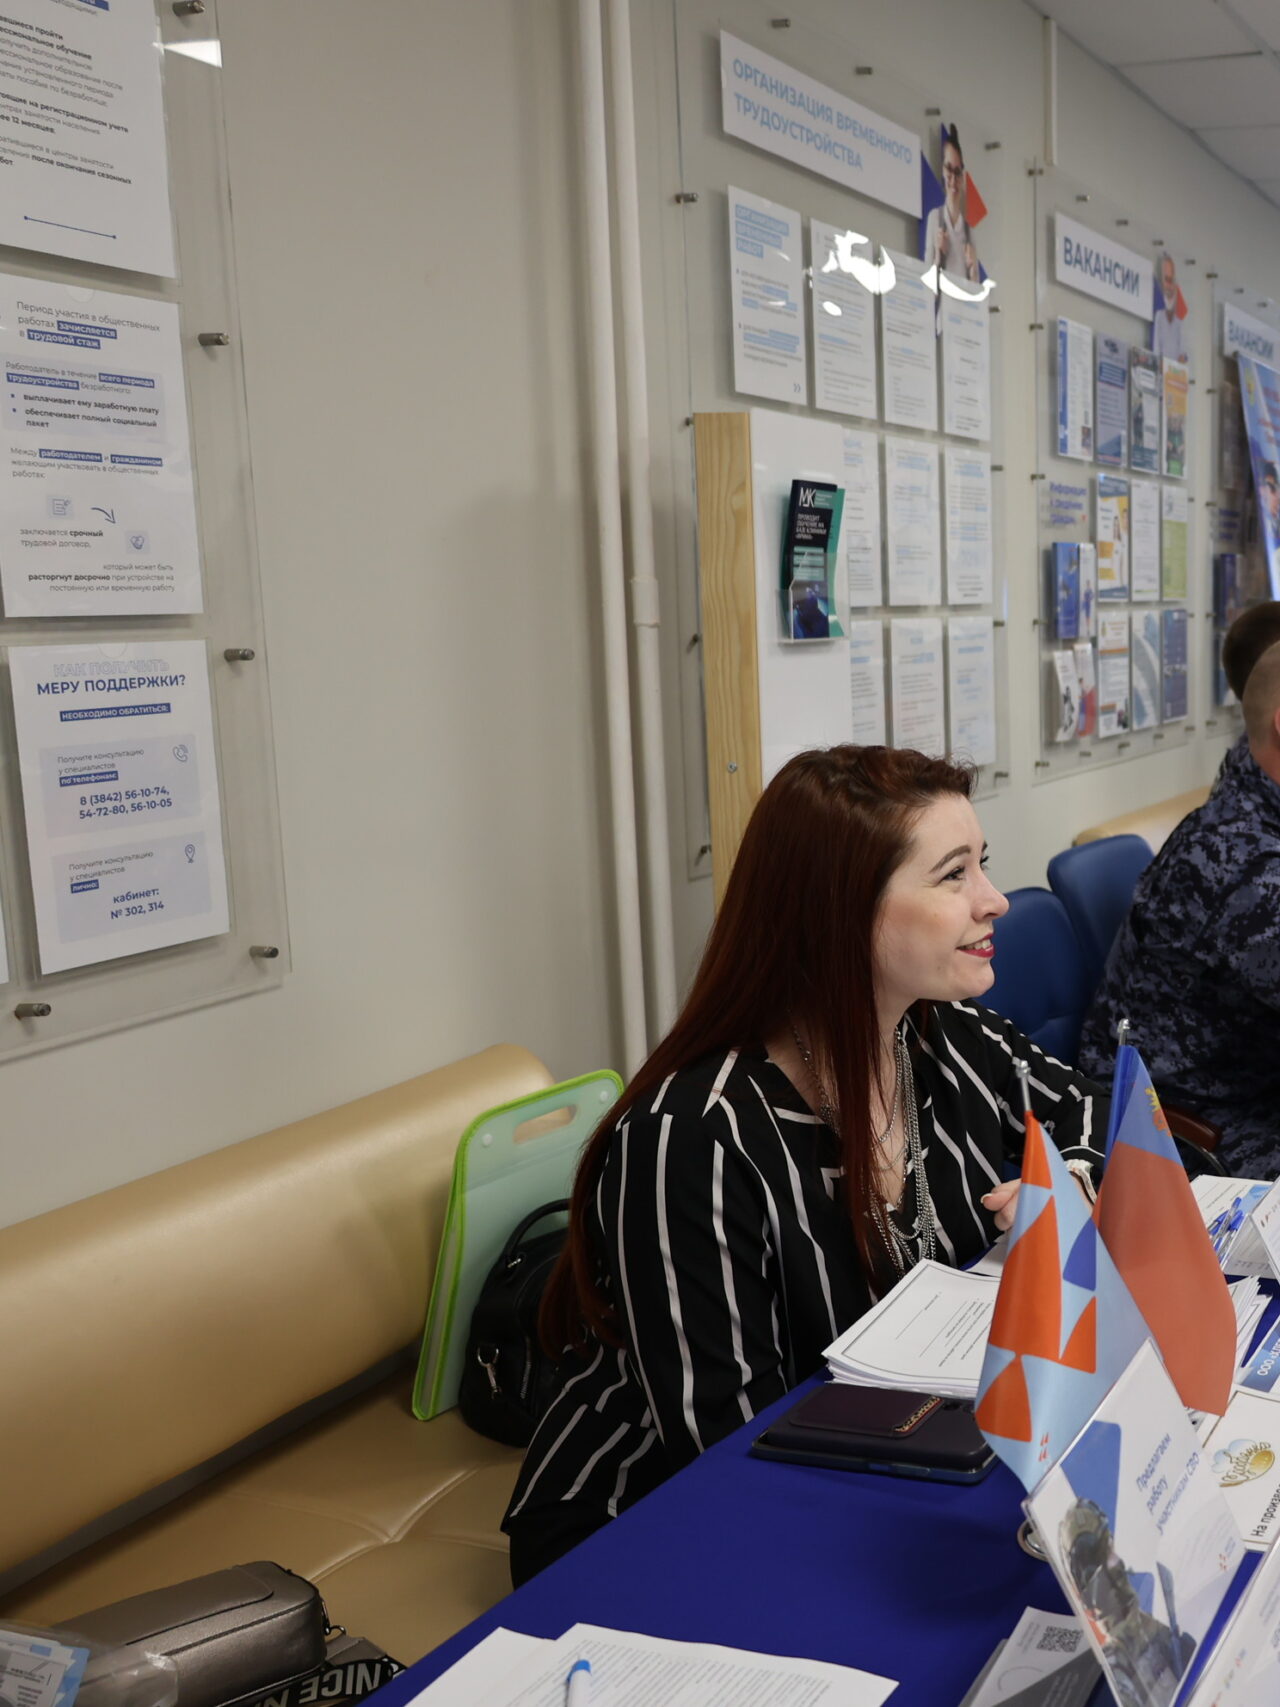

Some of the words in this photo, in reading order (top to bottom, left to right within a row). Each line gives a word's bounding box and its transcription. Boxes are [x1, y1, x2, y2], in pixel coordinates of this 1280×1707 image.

[55, 44, 91, 60] обучение
[40, 103, 107, 126] регистрационном
[732, 57, 832, 124] ОРГАНИЗАЦИЯ
[836, 110, 911, 164] ВРЕМЕННОГО
[734, 91, 862, 168] ТРУДОУСТРОЙСТВА
[31, 154, 54, 165] после
[97, 171, 131, 184] сезонных
[1063, 236, 1139, 293] ВАКАНСИИ
[16, 300, 53, 315] Период
[54, 308, 89, 319] участия
[98, 315, 159, 331] общественных
[17, 316, 55, 328] работах
[58, 322, 115, 337] зачисляется
[29, 331, 74, 344] трудовой
[76, 338, 98, 347] стаж
[5, 361, 59, 375] Работодатель
[100, 374, 120, 382] всего
[121, 377, 153, 386] периода
[8, 374, 77, 387] трудоустройства
[23, 394, 75, 404] выплачивает
[77, 400, 91, 408] ему
[93, 401, 137, 412] заработную
[138, 406, 158, 415] плату
[24, 408, 79, 419] обеспечивает
[81, 414, 110, 422] полный
[112, 417, 156, 427] социальный
[26, 419, 49, 427] пакет
[41, 450, 100, 460] работодателем
[20, 539, 57, 547] трудовой
[152, 584, 174, 592] работу
[53, 662, 88, 677] КАК
[89, 658, 169, 676] ПОЛУЧИТЬ
[36, 680, 79, 695] МЕРУ
[84, 674, 185, 692] ПОДДЕРЖКИ?
[62, 709, 117, 719] НЕОБХОДИМО
[118, 704, 168, 715] ОБРАТИТЬСЯ:
[57, 754, 92, 763] Получите
[93, 748, 144, 759] консультацию
[64, 762, 115, 773] специалистов
[79, 796, 86, 805] 8
[89, 791, 122, 806] (3842)
[124, 785, 169, 799] 56-10-74,
[79, 804, 128, 819] 54-72-80,
[130, 797, 172, 812] 56-10-05
[68, 860, 102, 870] Получите
[104, 851, 153, 864] консультацию
[75, 866, 125, 880] специалистов
[112, 888, 159, 903] кабинет:
[110, 909, 122, 919] №
[124, 904, 145, 916] 302,
[147, 900, 164, 911] 314
[1257, 1346, 1273, 1377] ООО
[1135, 1433, 1171, 1491] Предлагаем
[1146, 1475, 1168, 1515] работу
[1151, 1473, 1188, 1536] участникам
[1185, 1451, 1198, 1475] СВО
[1250, 1524, 1267, 1536] На
[299, 1663, 382, 1704] NICE
